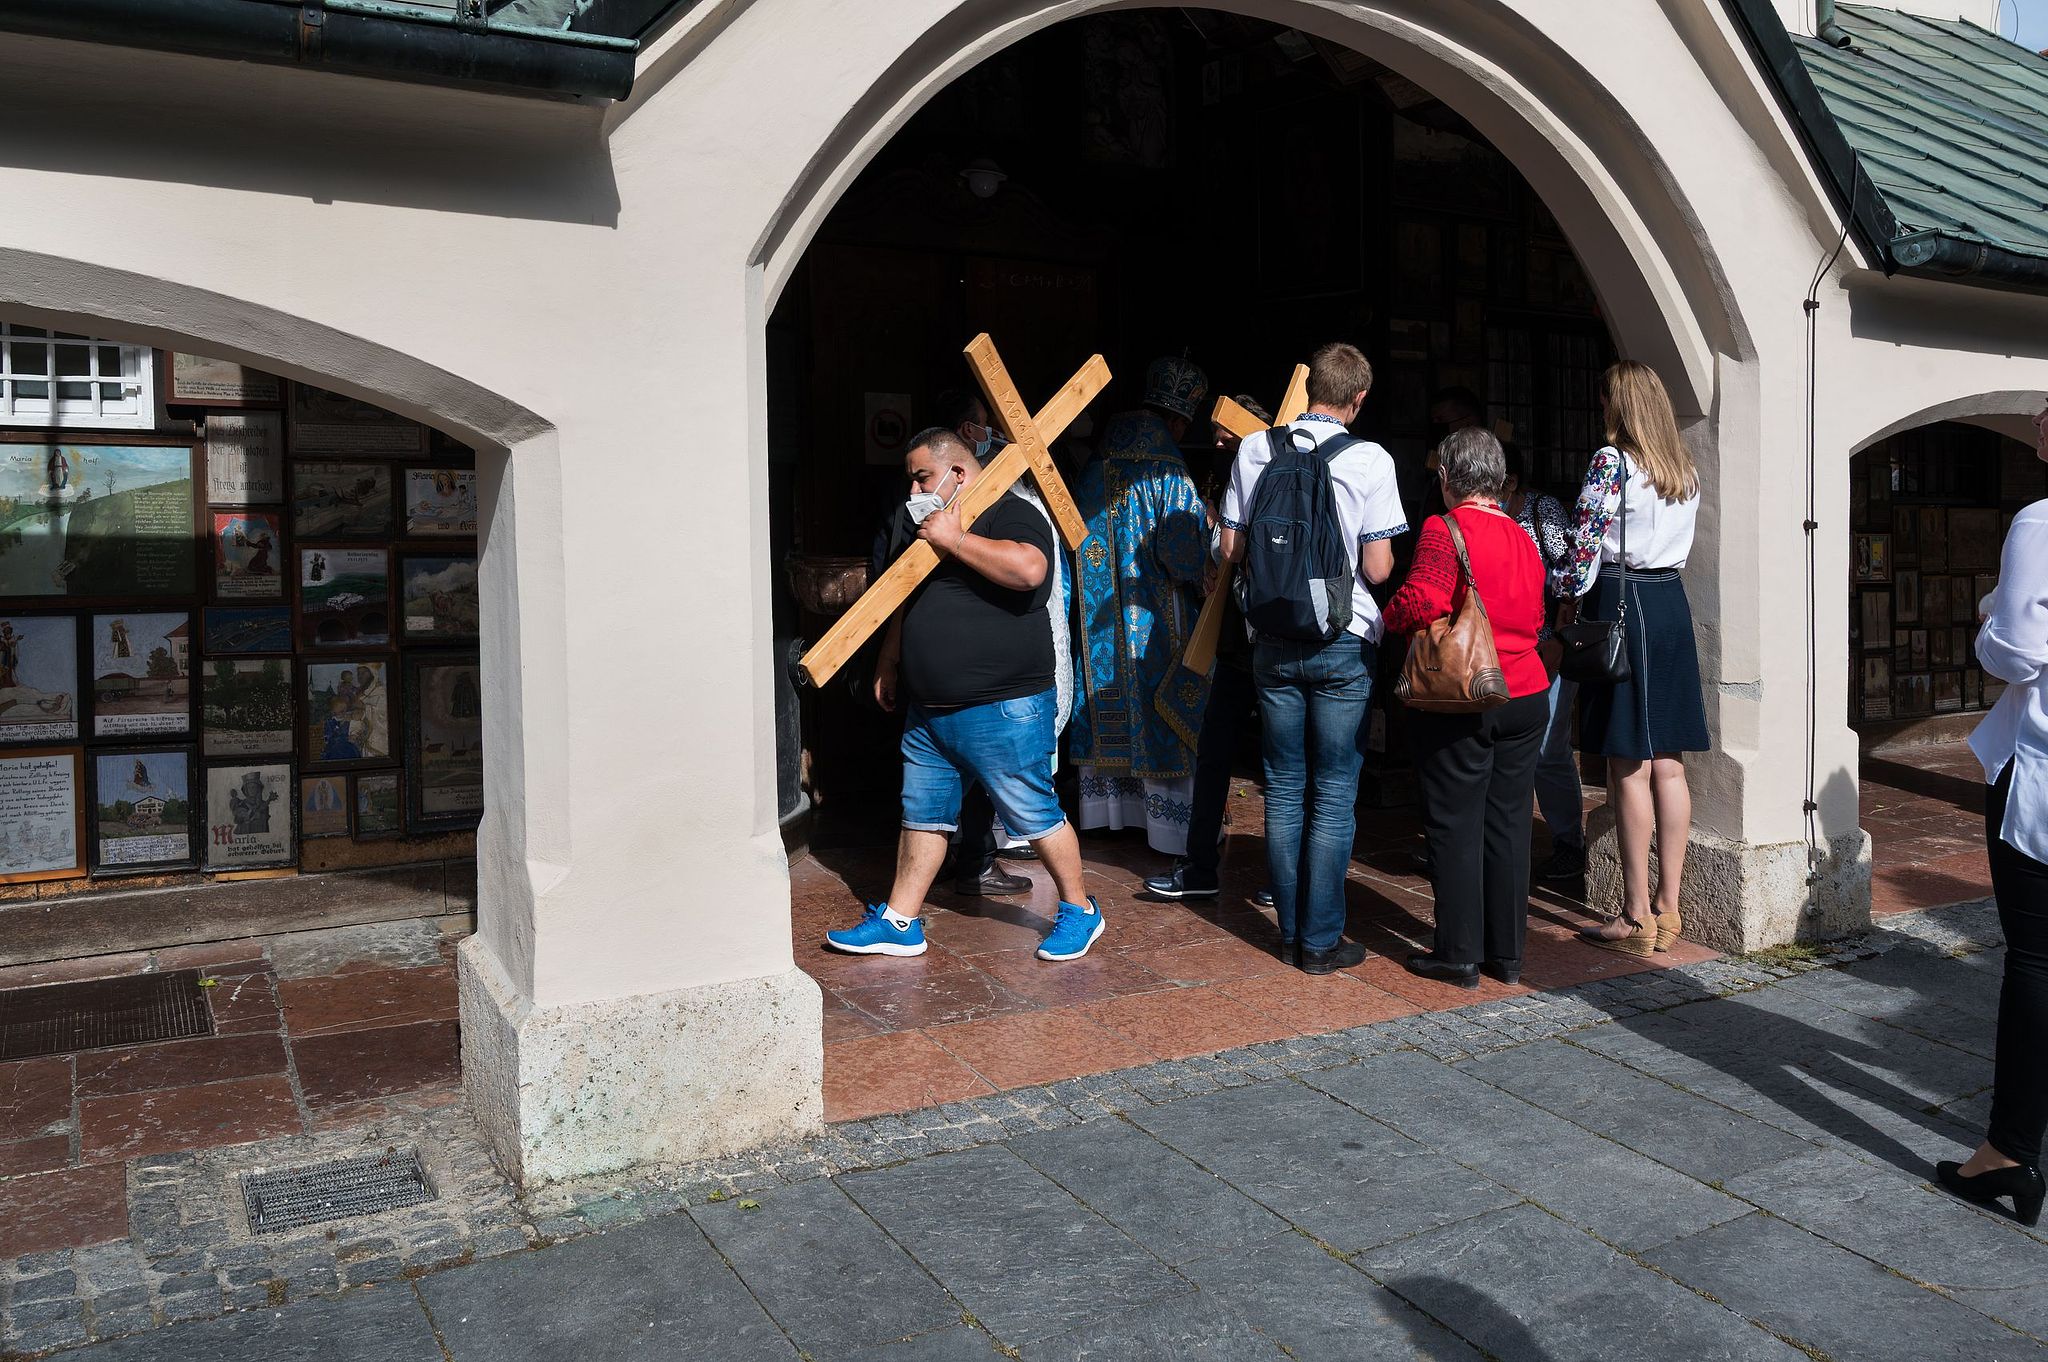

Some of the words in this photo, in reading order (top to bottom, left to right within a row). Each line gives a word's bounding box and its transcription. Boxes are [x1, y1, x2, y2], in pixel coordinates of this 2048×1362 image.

[999, 390, 1035, 452] Maria
[212, 443, 225, 456] der
[239, 461, 248, 475] ist
[411, 471, 435, 481] Maria
[213, 477, 236, 494] streng
[240, 479, 273, 496] untersagt
[20, 762, 32, 770] hat
[30, 760, 58, 772] geholfen!
[228, 845, 240, 853] hat
[242, 843, 270, 852] geholfen
[272, 841, 282, 849] bei
[227, 850, 258, 858] schwerer
